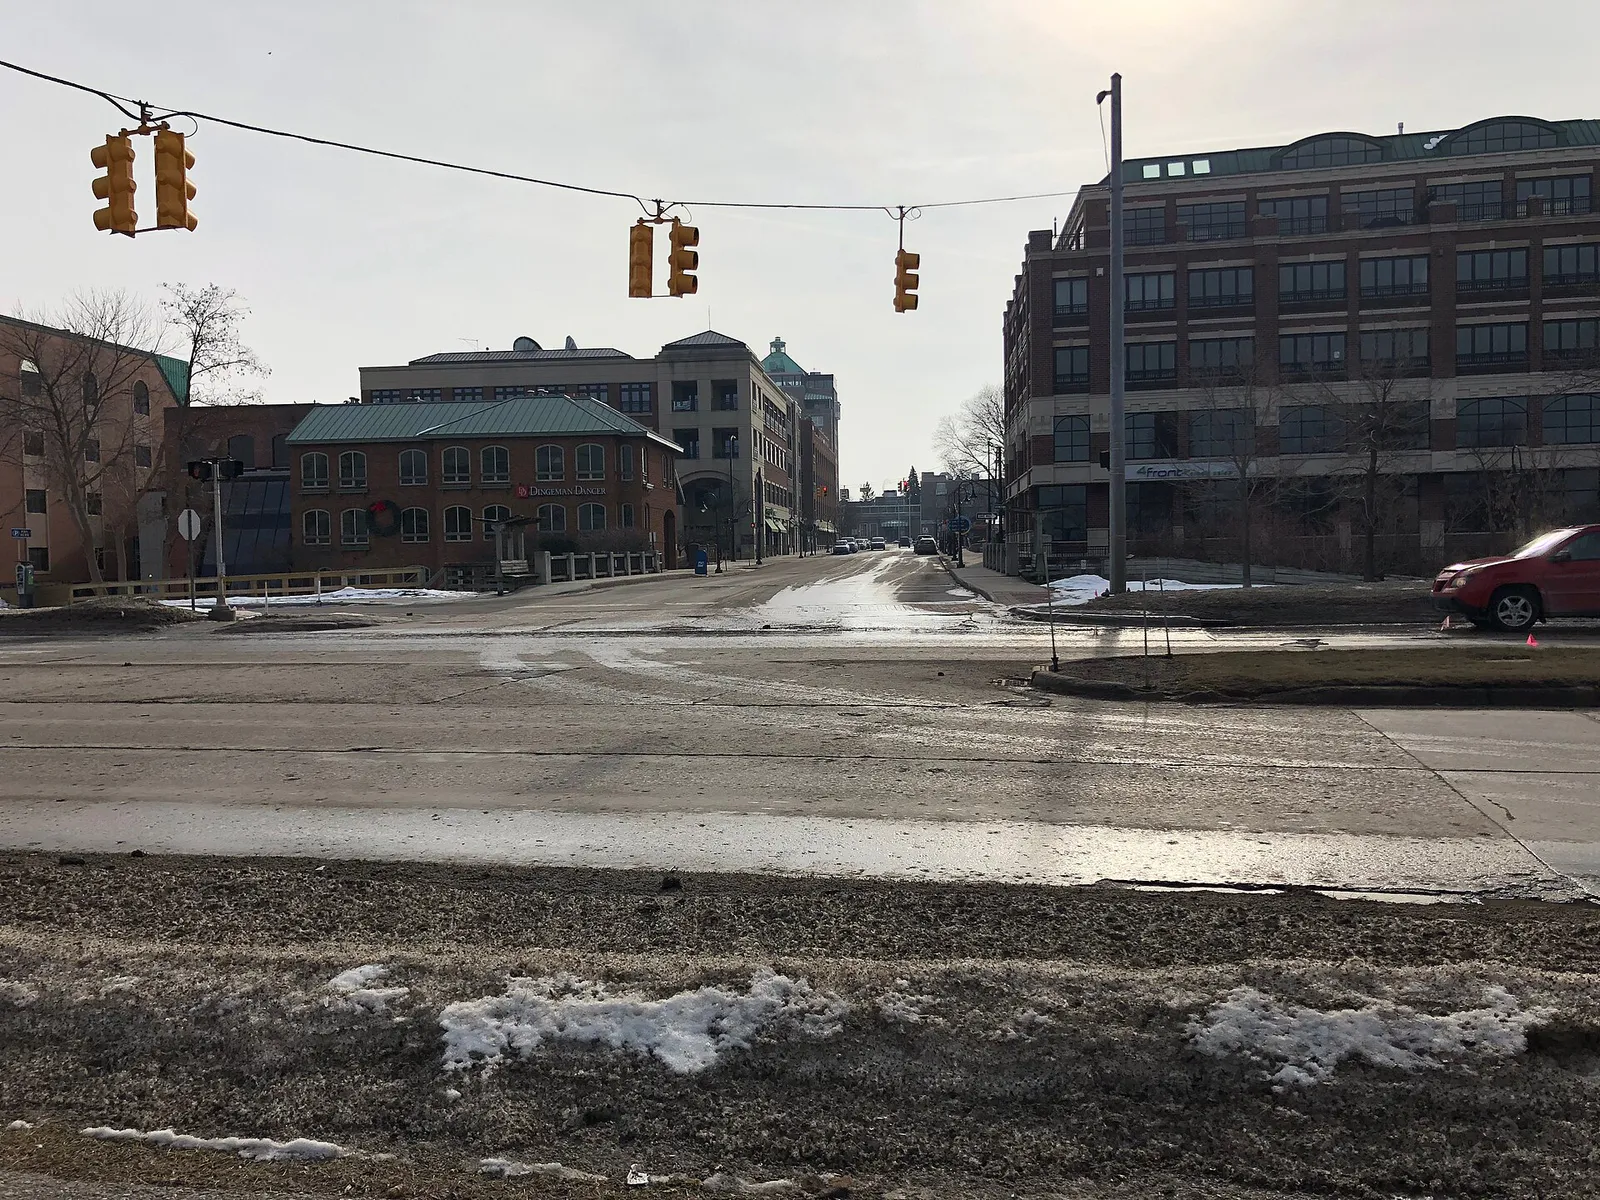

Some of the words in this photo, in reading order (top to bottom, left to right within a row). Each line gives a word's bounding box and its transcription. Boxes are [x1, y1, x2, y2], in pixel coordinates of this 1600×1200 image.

[1136, 465, 1183, 477] 4front
[530, 486, 573, 496] DINGEMAN
[575, 485, 606, 495] DANCER
